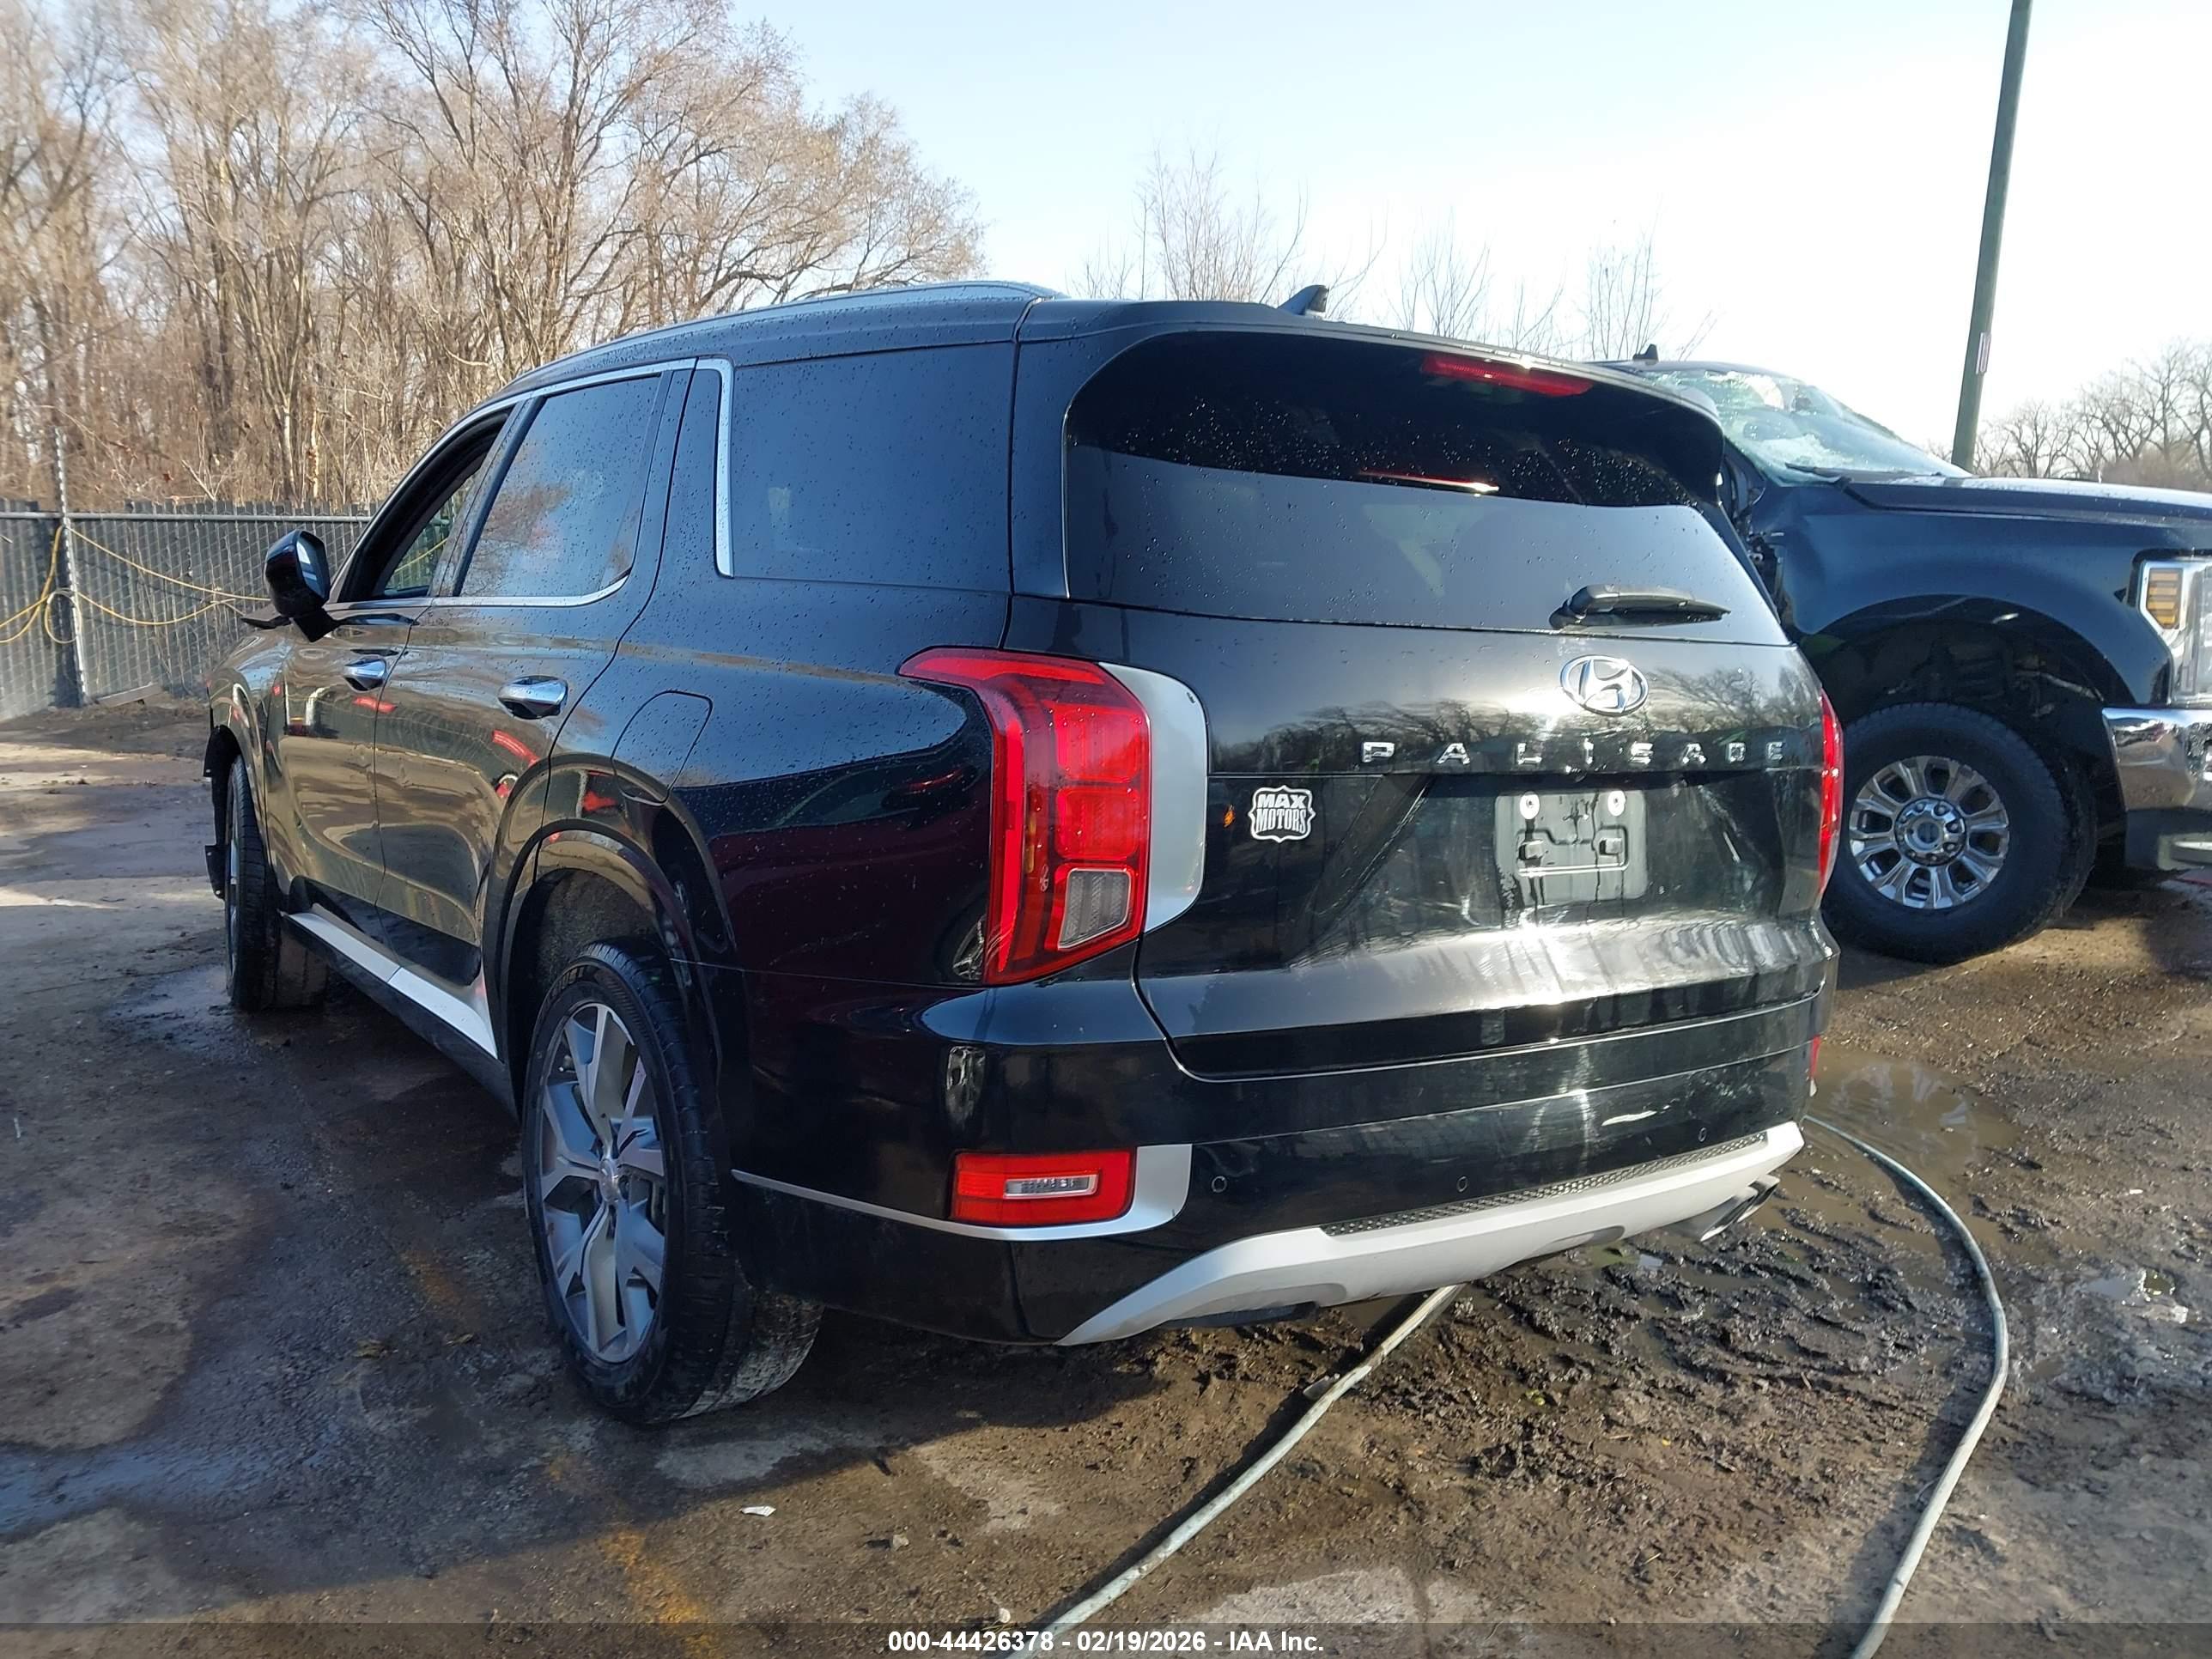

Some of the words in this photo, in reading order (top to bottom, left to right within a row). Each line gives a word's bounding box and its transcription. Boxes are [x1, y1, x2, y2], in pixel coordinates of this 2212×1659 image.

[1362, 739, 1784, 766] PALISADE
[1256, 793, 1307, 809] MAX
[1255, 808, 1307, 834] MOTORS
